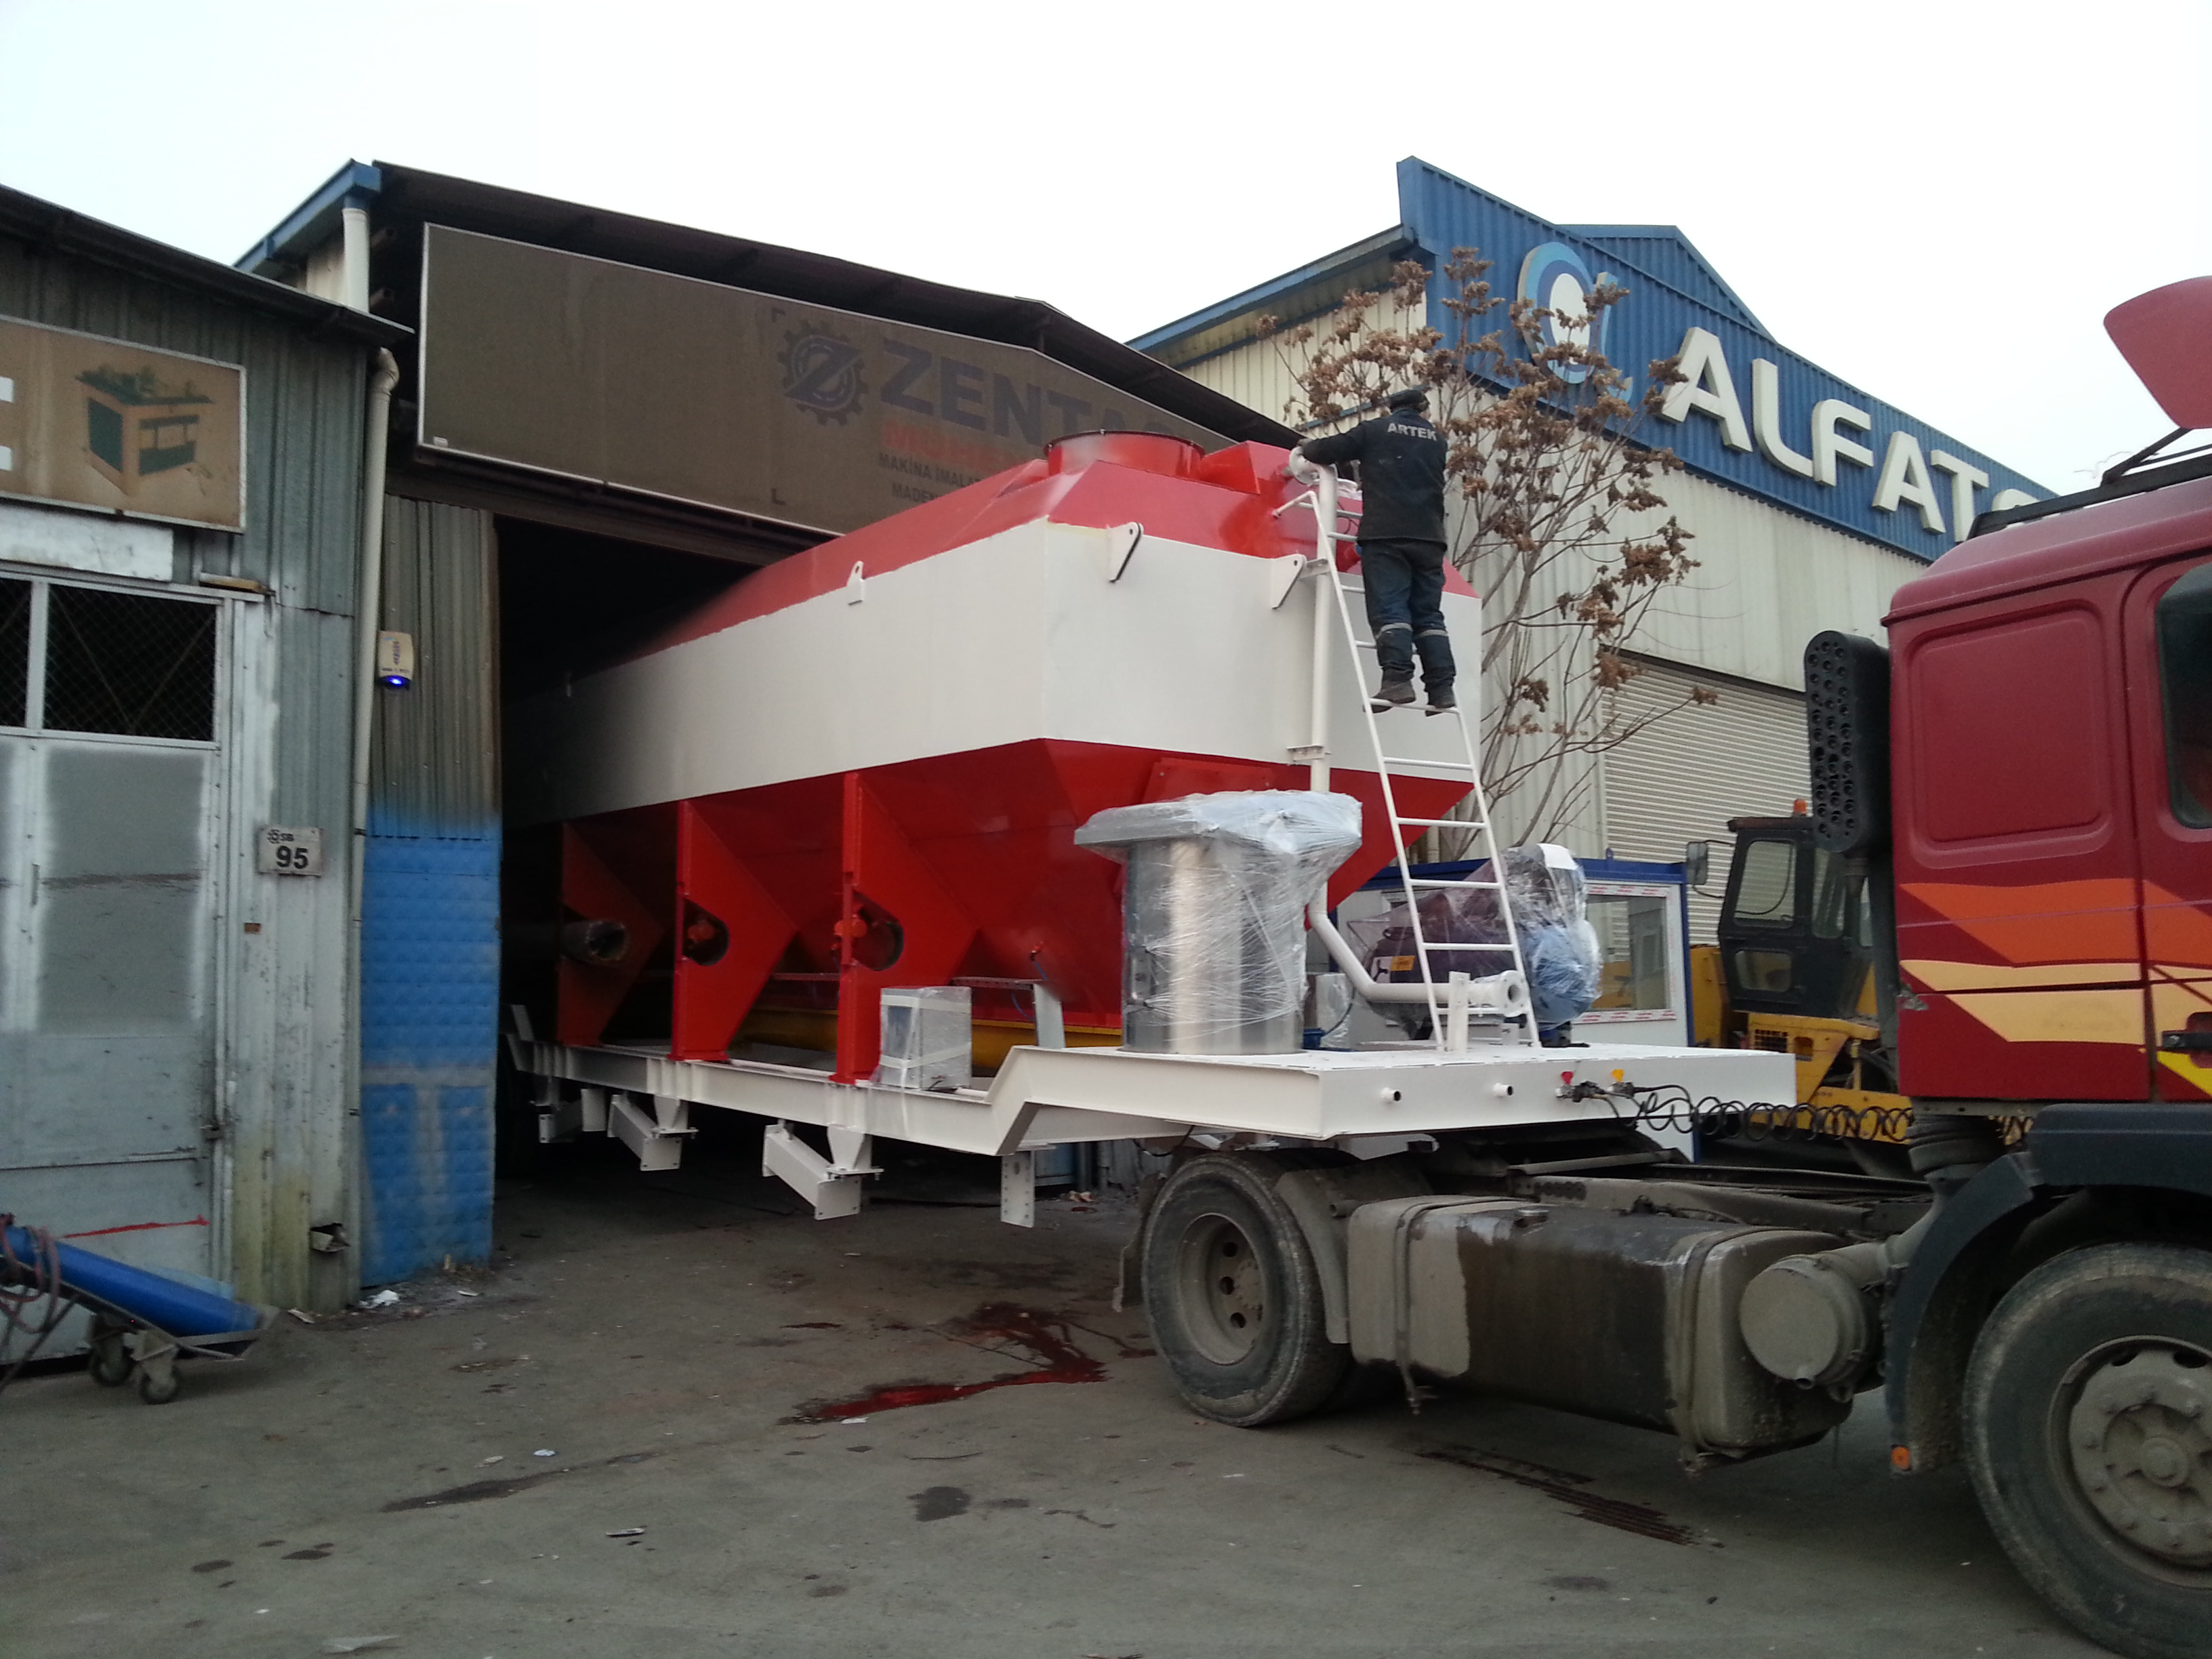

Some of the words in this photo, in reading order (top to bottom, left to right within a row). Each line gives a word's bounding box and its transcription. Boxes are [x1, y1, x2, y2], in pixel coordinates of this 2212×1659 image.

[880, 337, 1176, 448] ZENT
[1387, 422, 1437, 441] ARTEK
[1656, 327, 2040, 543] ALFAT
[276, 846, 308, 869] 95
